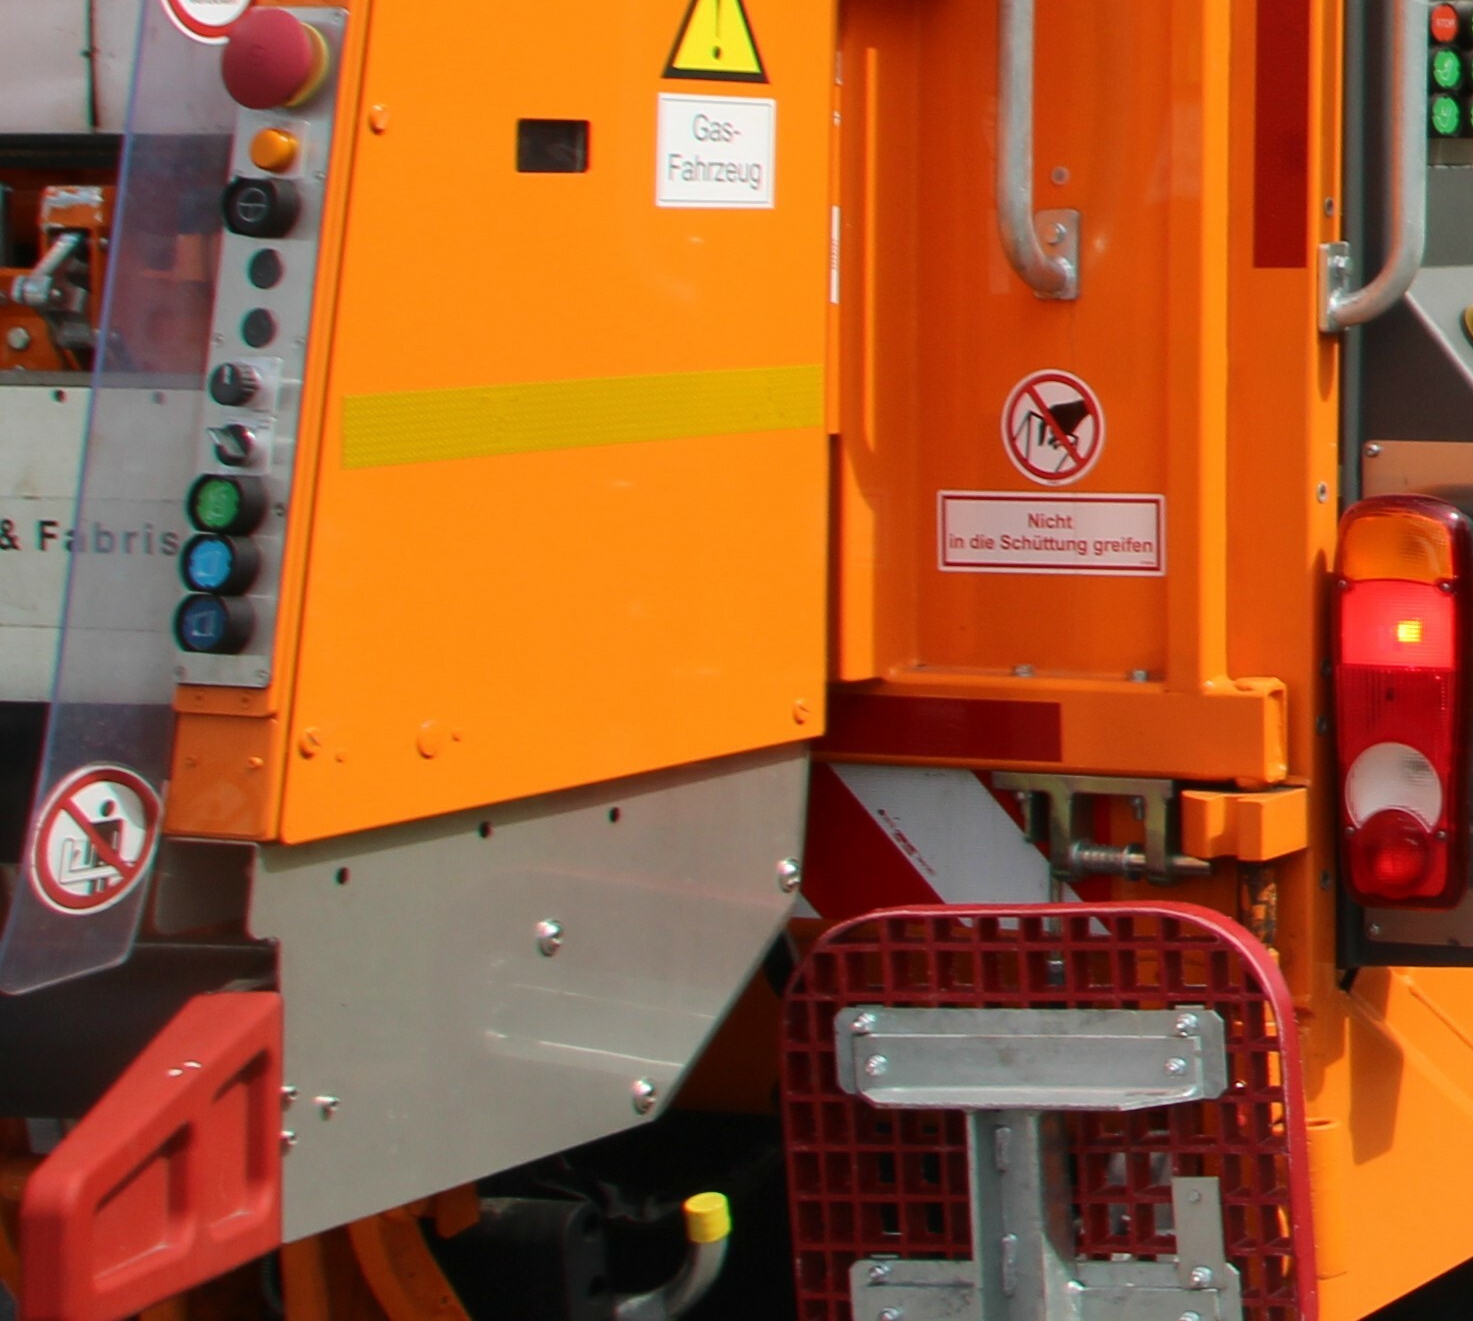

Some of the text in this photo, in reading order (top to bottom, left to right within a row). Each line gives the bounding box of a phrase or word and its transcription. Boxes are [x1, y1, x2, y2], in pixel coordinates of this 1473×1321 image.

[691, 112, 742, 143] Gas-
[667, 152, 762, 191] Fahrzeug
[1027, 512, 1074, 530] Nicht
[0, 518, 181, 557] & Fabris
[948, 533, 1154, 557] in die Schüttung greifen
